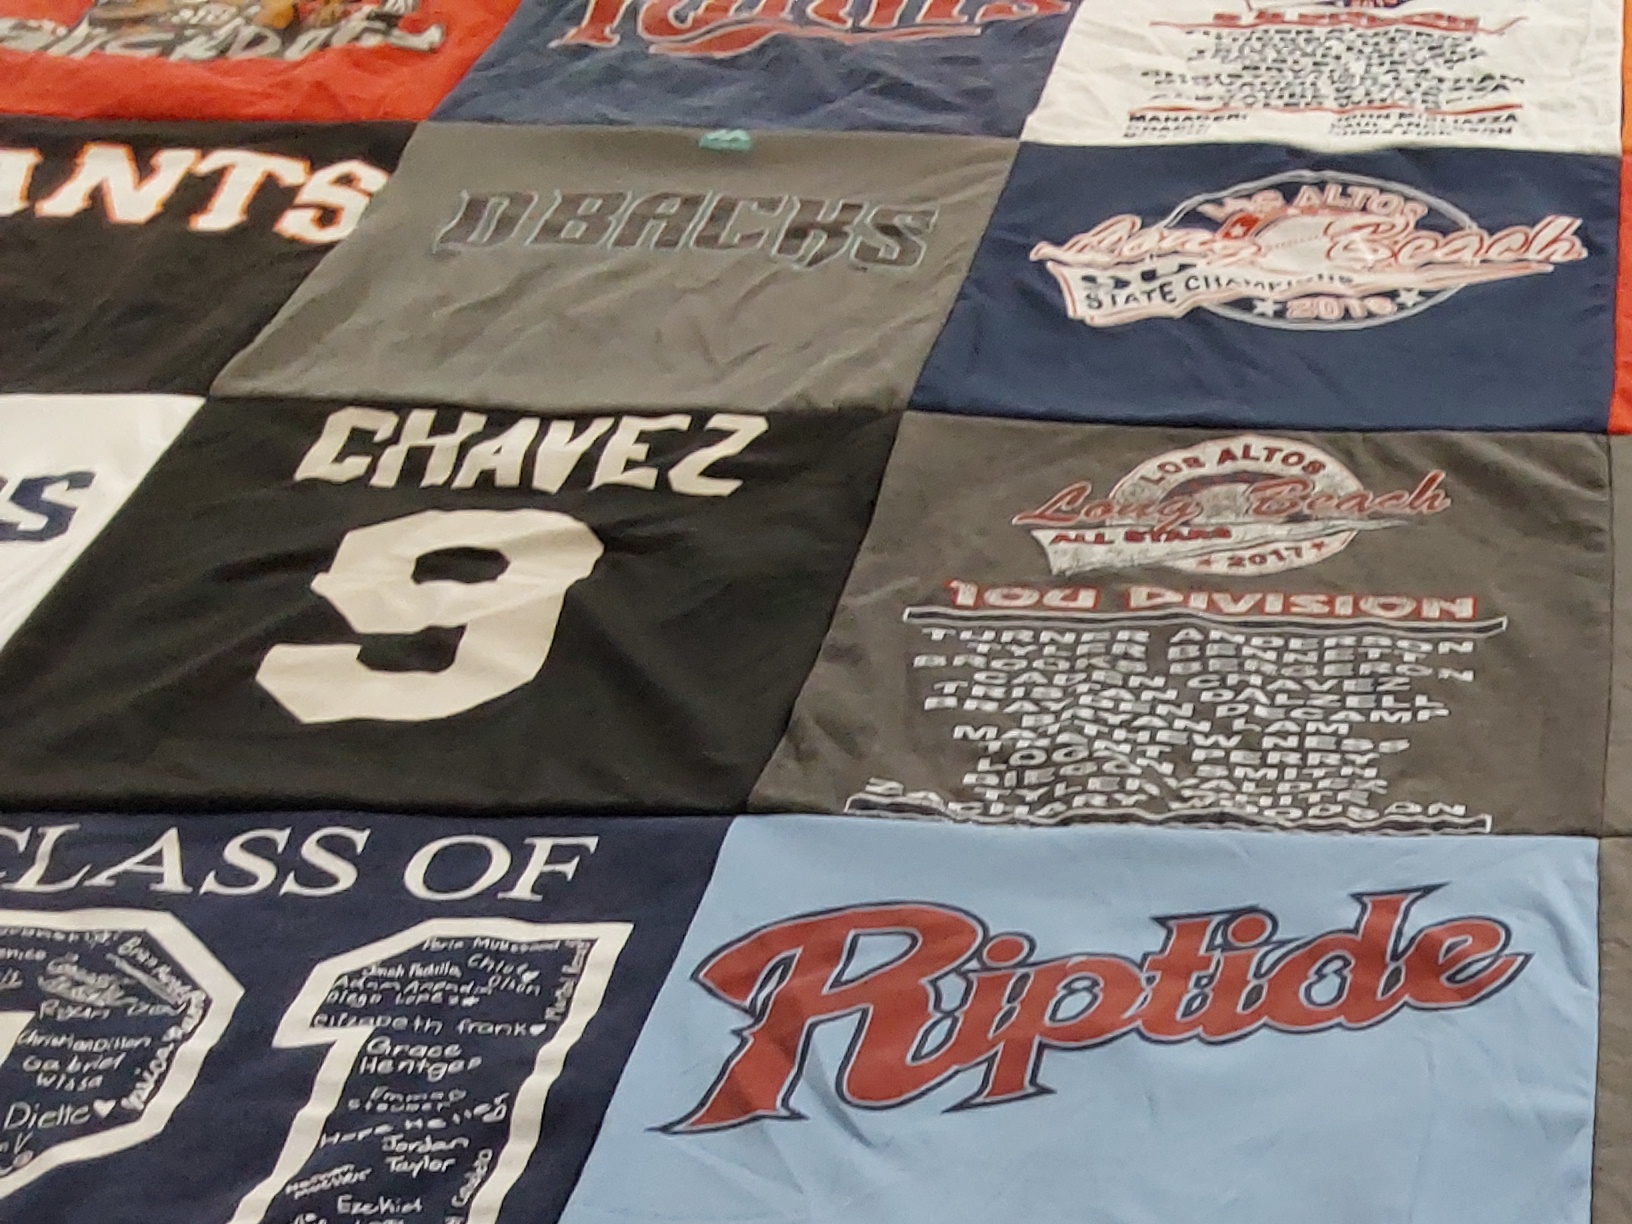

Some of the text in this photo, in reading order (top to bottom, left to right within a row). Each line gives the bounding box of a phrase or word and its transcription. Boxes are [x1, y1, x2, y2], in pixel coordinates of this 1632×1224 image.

[431, 188, 939, 271] DBACKS
[1324, 214, 1589, 269] Beach
[292, 405, 770, 497] CHAVEZ
[1140, 443, 1328, 488] LOS ALTOS
[1011, 468, 1453, 534] Long Beach
[1226, 543, 1305, 570] 2017
[254, 507, 606, 725] 9
[1124, 584, 1480, 622] DIVISION
[1186, 672, 1412, 693] CHAVEZ
[1199, 687, 1446, 709] DALZELL
[400, 834, 600, 902] OF
[645, 881, 1536, 1135] Riptide
[385, 1154, 457, 1178] Taylor
